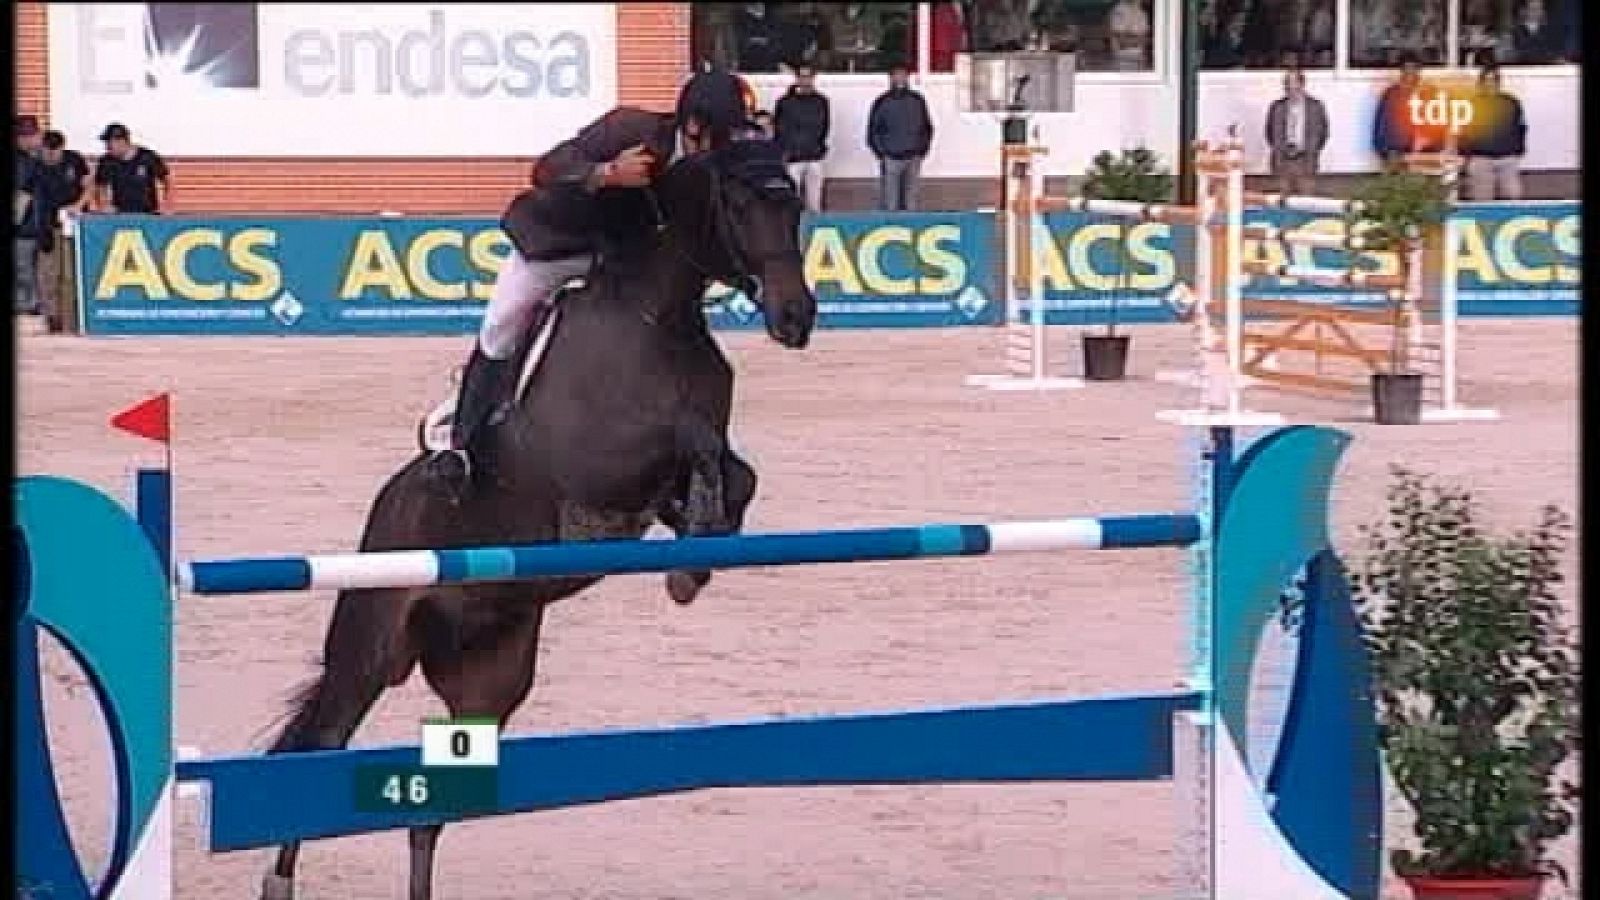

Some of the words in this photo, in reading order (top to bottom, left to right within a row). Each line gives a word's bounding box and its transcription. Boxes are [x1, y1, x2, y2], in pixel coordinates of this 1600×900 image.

[284, 9, 590, 98] endesa
[95, 228, 283, 300] ACS
[340, 228, 512, 300] ACS
[803, 224, 966, 295] ACS
